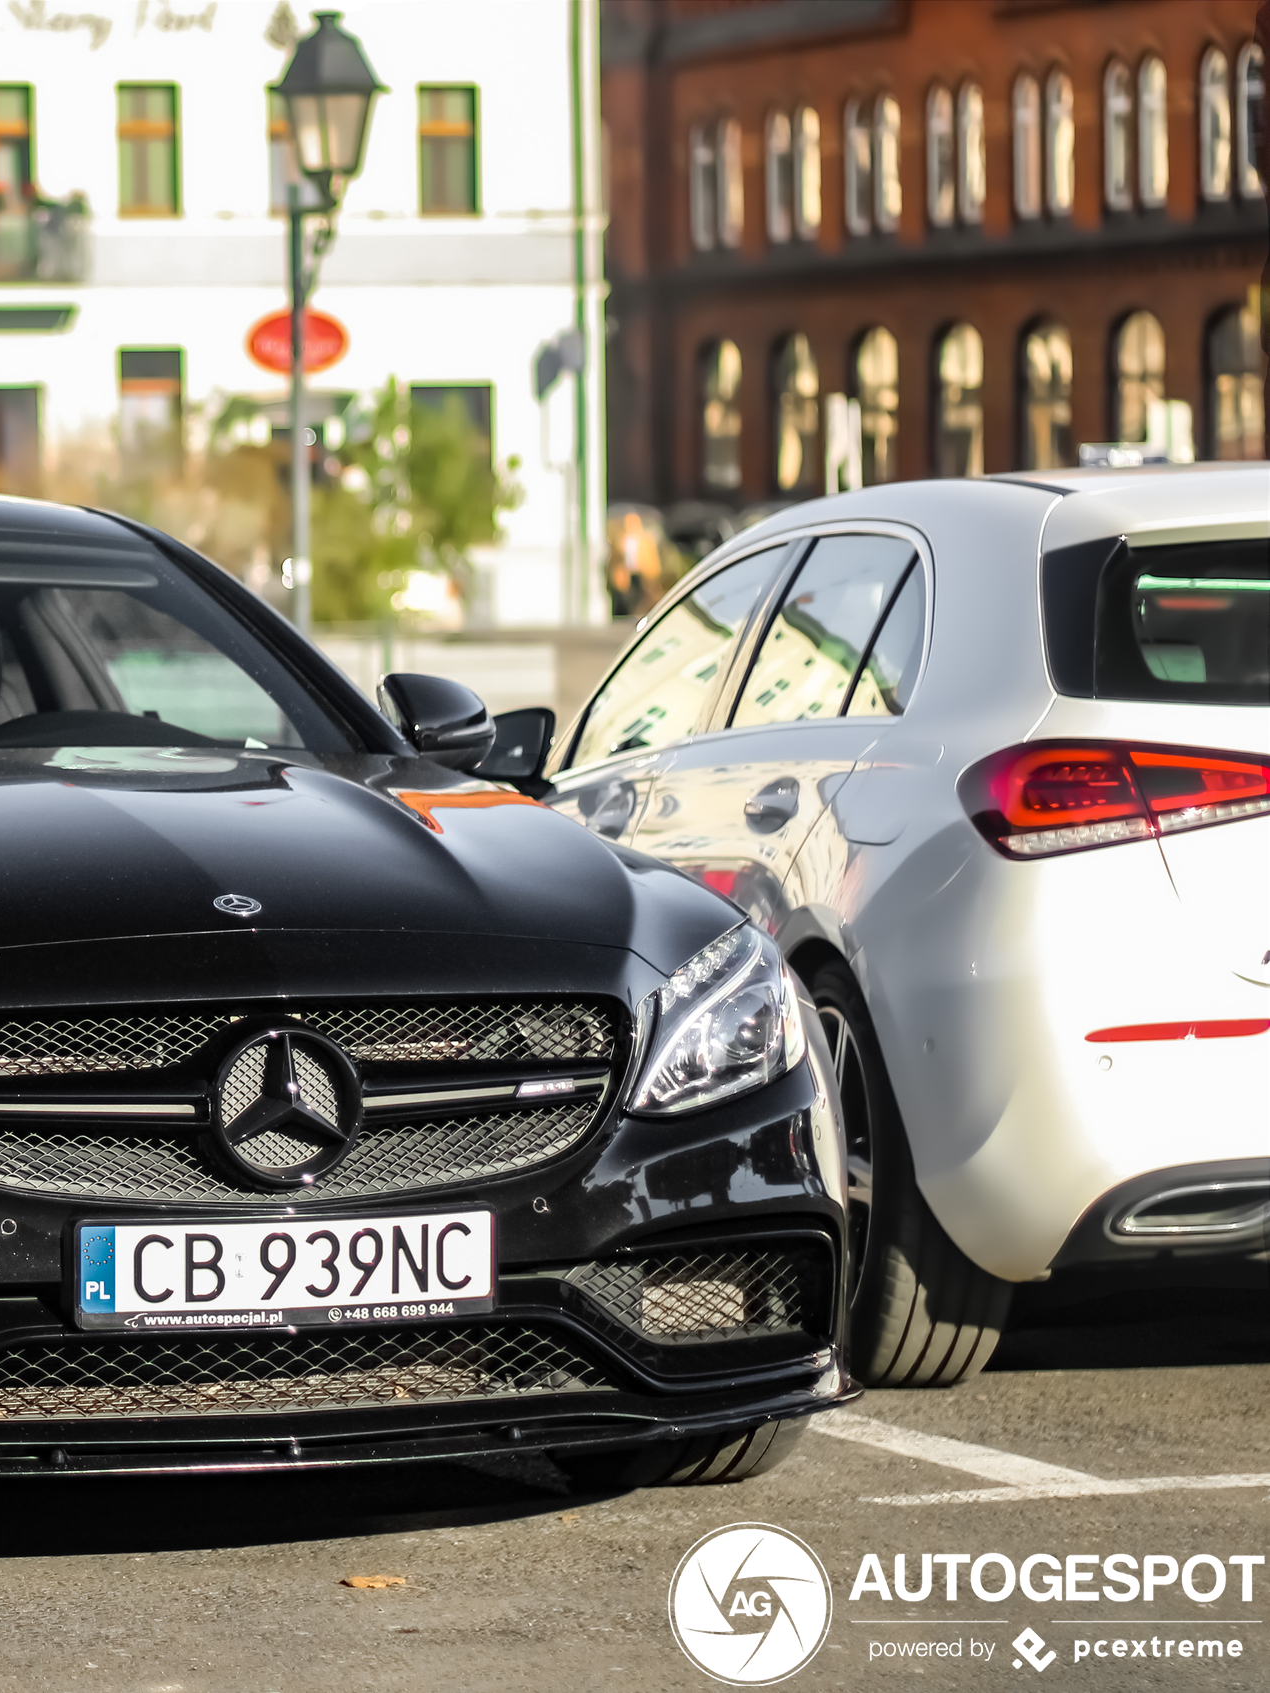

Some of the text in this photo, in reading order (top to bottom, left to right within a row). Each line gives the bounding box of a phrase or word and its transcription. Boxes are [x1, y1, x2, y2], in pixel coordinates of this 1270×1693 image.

[133, 1222, 472, 1303] CB 939NC
[85, 1280, 111, 1300] PL
[144, 1311, 283, 1327] www.autospecjal.pl
[344, 1302, 454, 1320] +48 668 699 944
